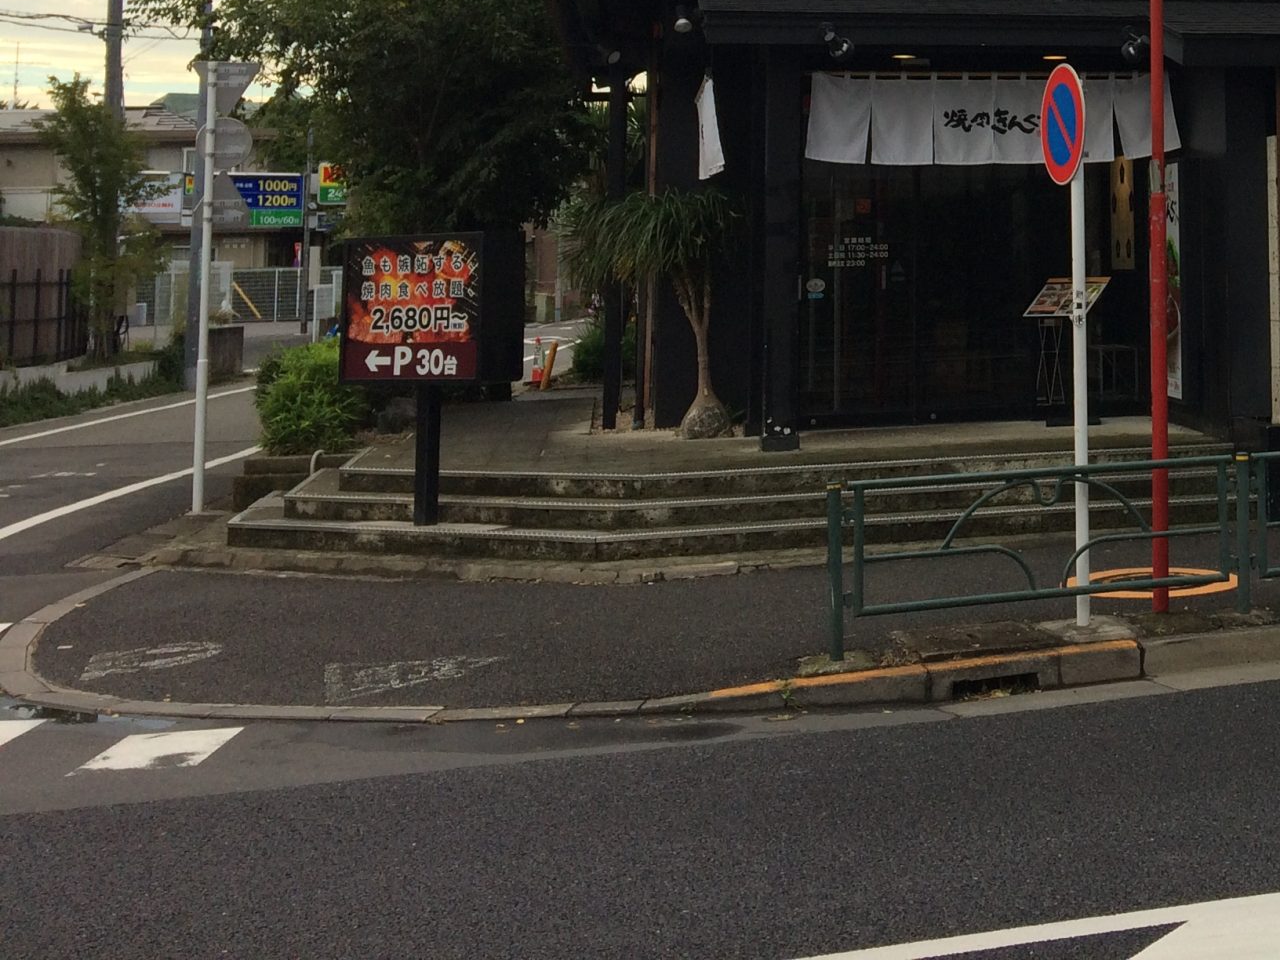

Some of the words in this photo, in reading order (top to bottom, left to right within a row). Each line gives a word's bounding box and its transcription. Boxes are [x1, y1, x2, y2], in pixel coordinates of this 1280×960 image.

[943, 108, 1041, 134] 焼肉きんぐ
[257, 180, 297, 191] 1000円
[257, 195, 297, 206] 1200円
[362, 254, 464, 275] 魚も嫉妬する
[361, 280, 465, 301] 焼肉食べ放題
[393, 346, 413, 376] P
[415, 348, 458, 376] 30台
